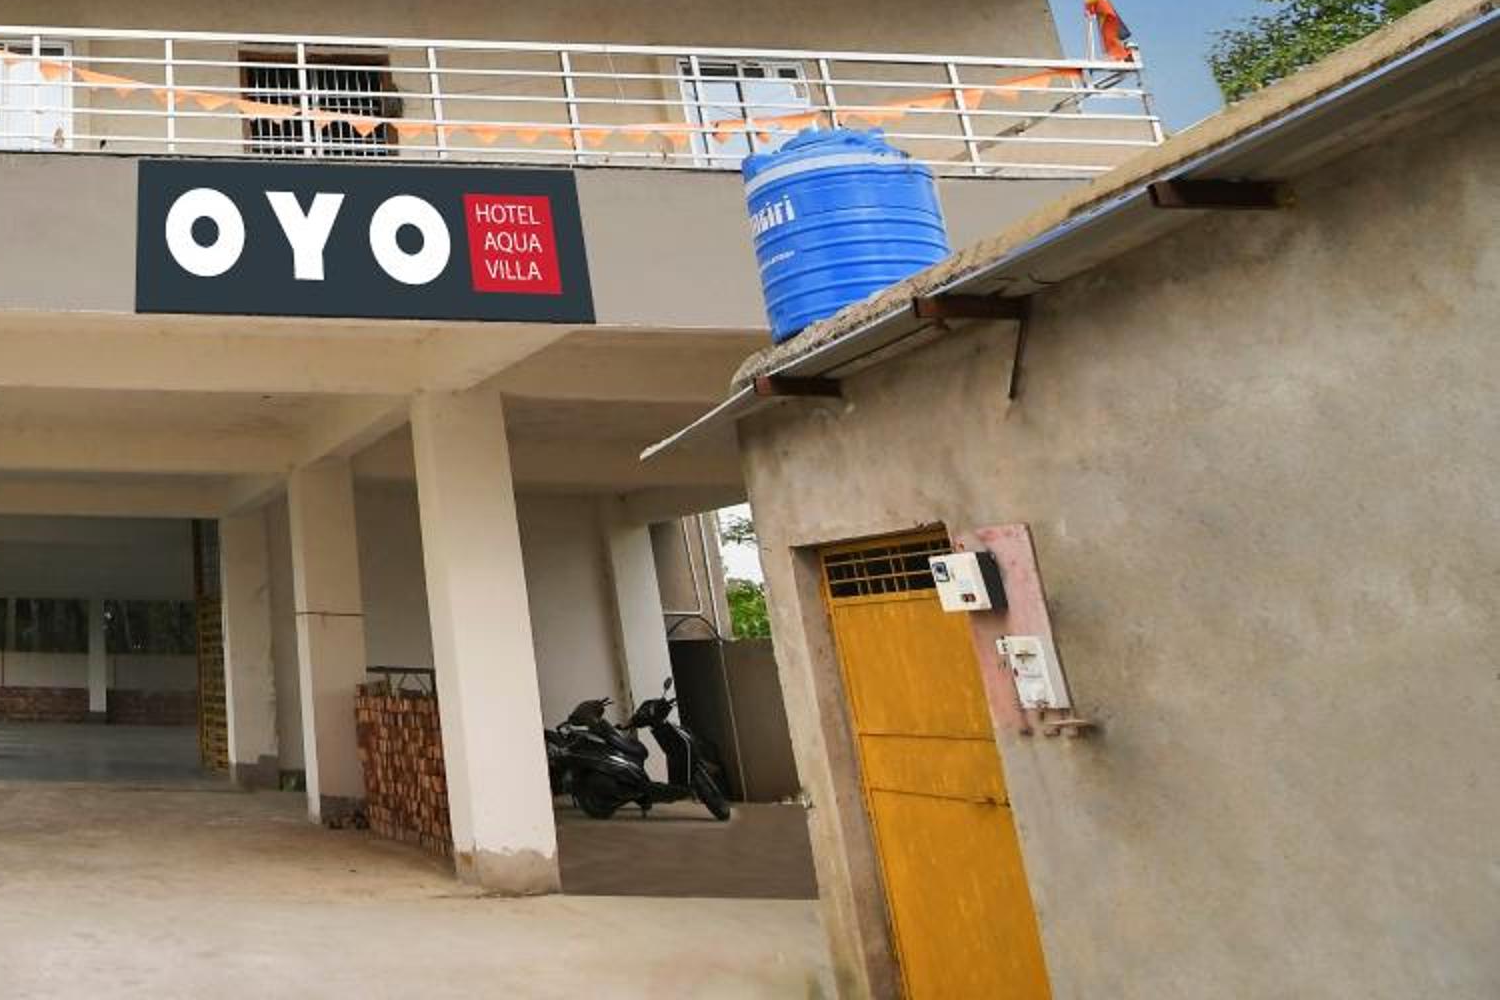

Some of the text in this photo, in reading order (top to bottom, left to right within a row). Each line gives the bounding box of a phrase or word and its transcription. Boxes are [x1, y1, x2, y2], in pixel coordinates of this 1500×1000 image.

[475, 203, 541, 226] HOTEL
[165, 187, 451, 286] OYO
[484, 231, 543, 254] AQUA
[485, 259, 543, 281] VILLA
